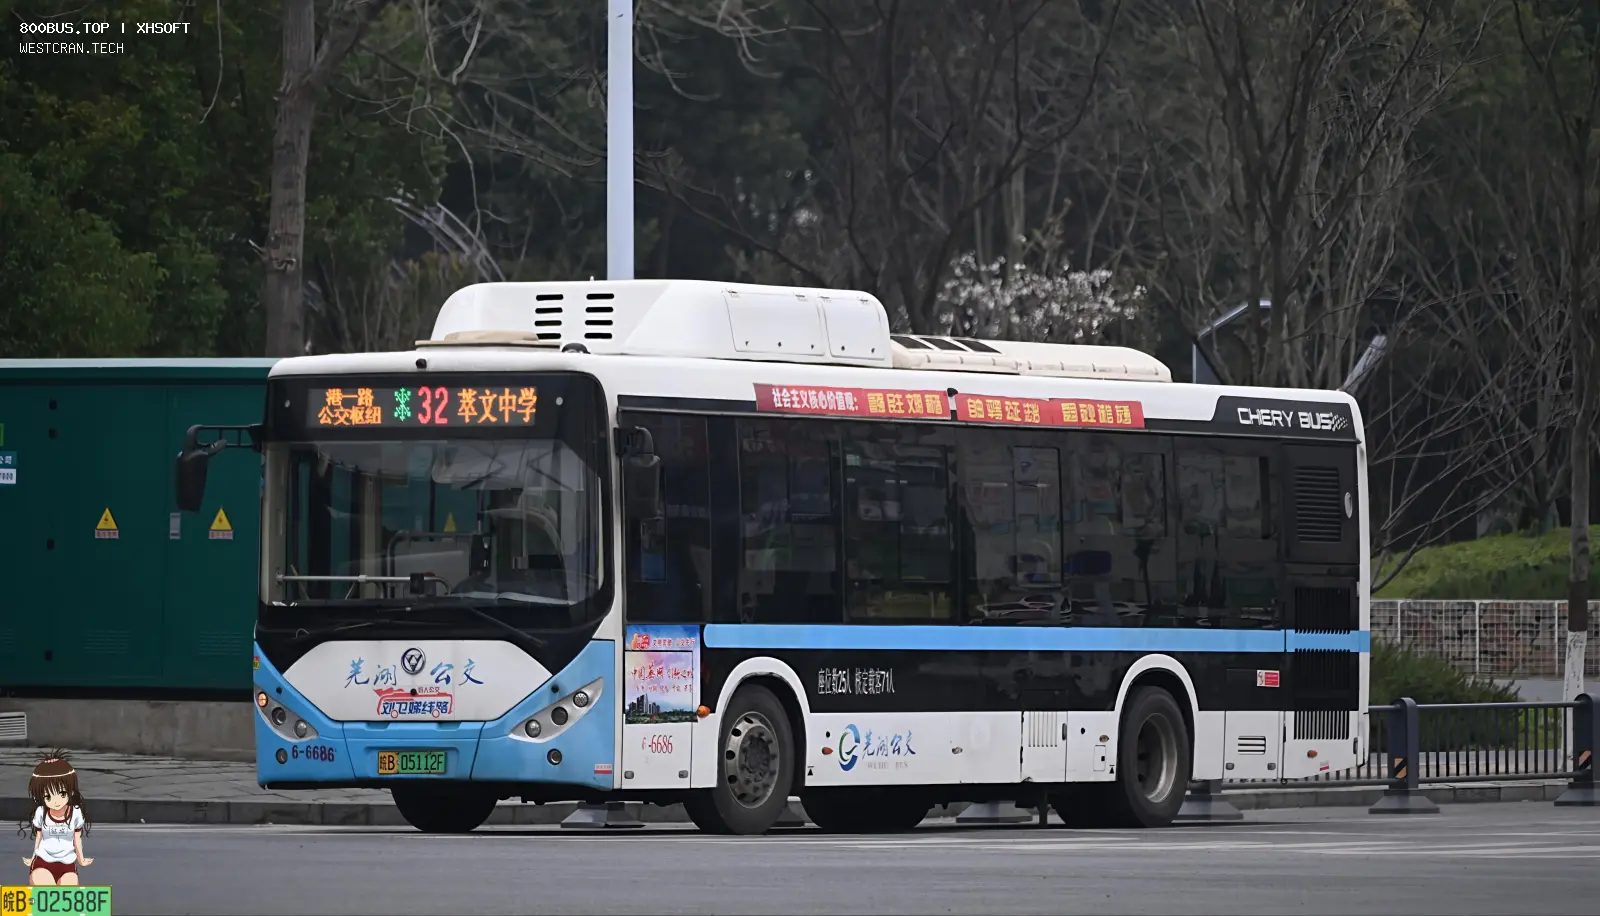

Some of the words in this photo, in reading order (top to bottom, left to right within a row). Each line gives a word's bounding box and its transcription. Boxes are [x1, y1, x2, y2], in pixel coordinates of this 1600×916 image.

[325, 388, 374, 407] 港一路
[417, 386, 449, 425] 32
[456, 387, 537, 424] 萃文中学
[317, 406, 382, 425] 公交枢纽
[1236, 407, 1294, 428] CHERY
[1297, 411, 1332, 431] BUS
[430, 658, 485, 686] 公交
[818, 668, 852, 695] 座位数25人
[291, 744, 335, 763] 6-6686
[401, 754, 444, 771] 05112F
